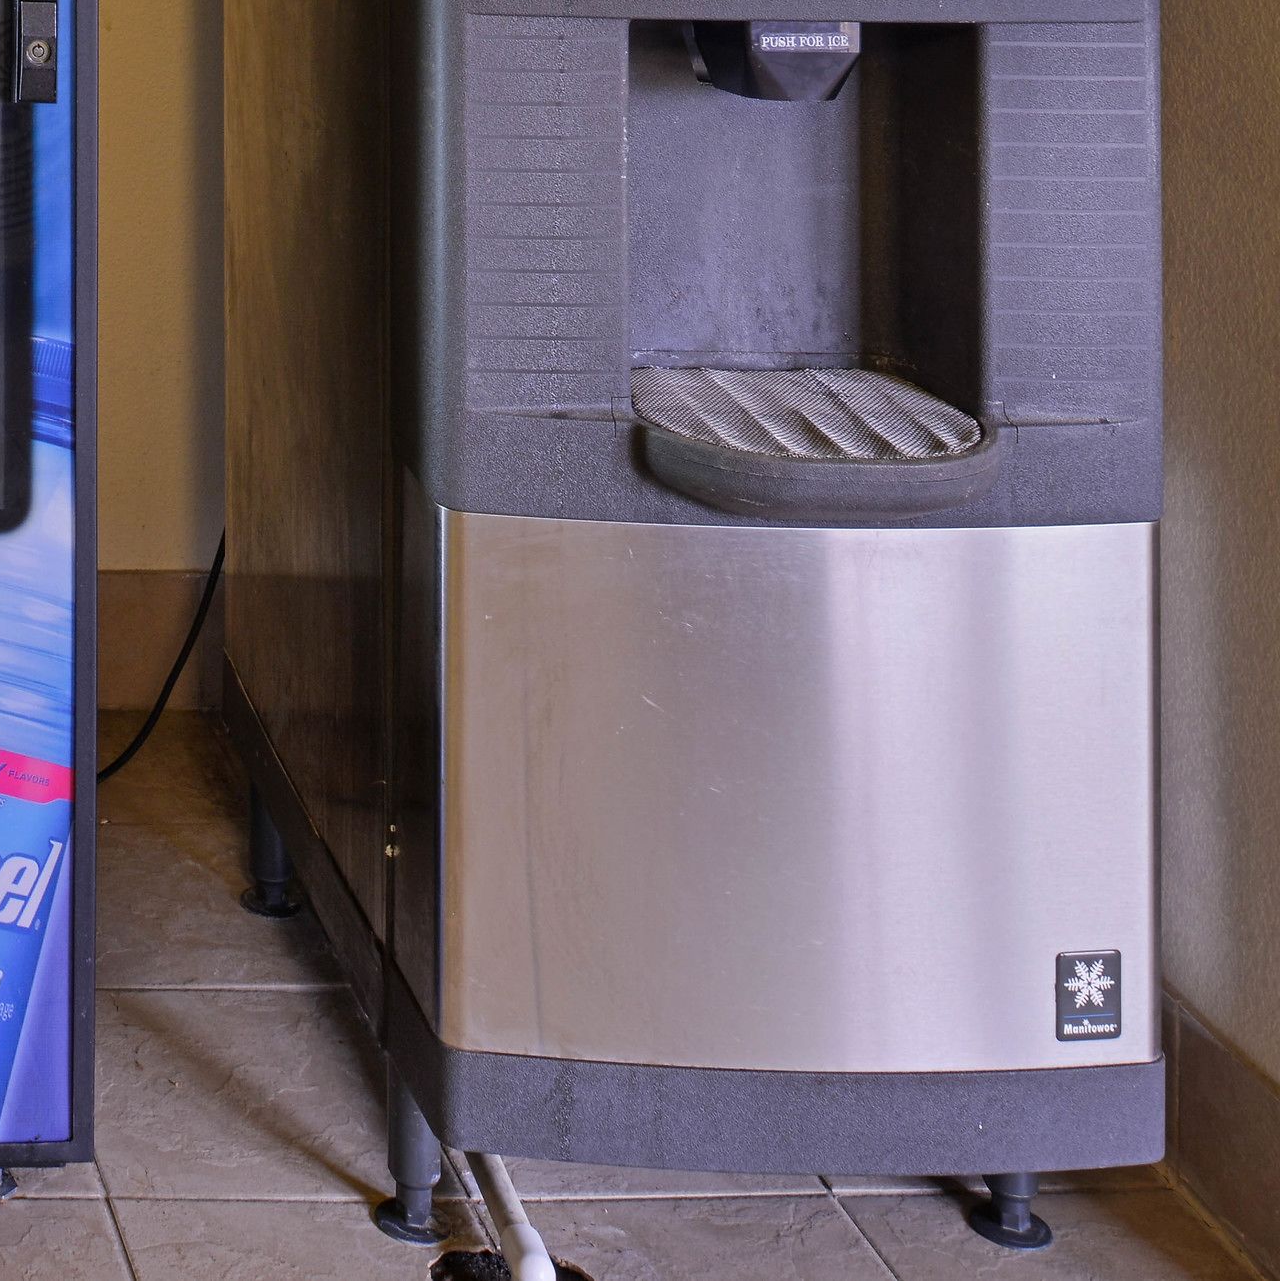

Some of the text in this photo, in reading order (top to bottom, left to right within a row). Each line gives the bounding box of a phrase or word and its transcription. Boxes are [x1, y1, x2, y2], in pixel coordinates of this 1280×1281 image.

[761, 35, 849, 48] PUSH FOR ICE
[9, 770, 50, 787] FLAVORS
[1063, 1021, 1116, 1035] Manitowoc
